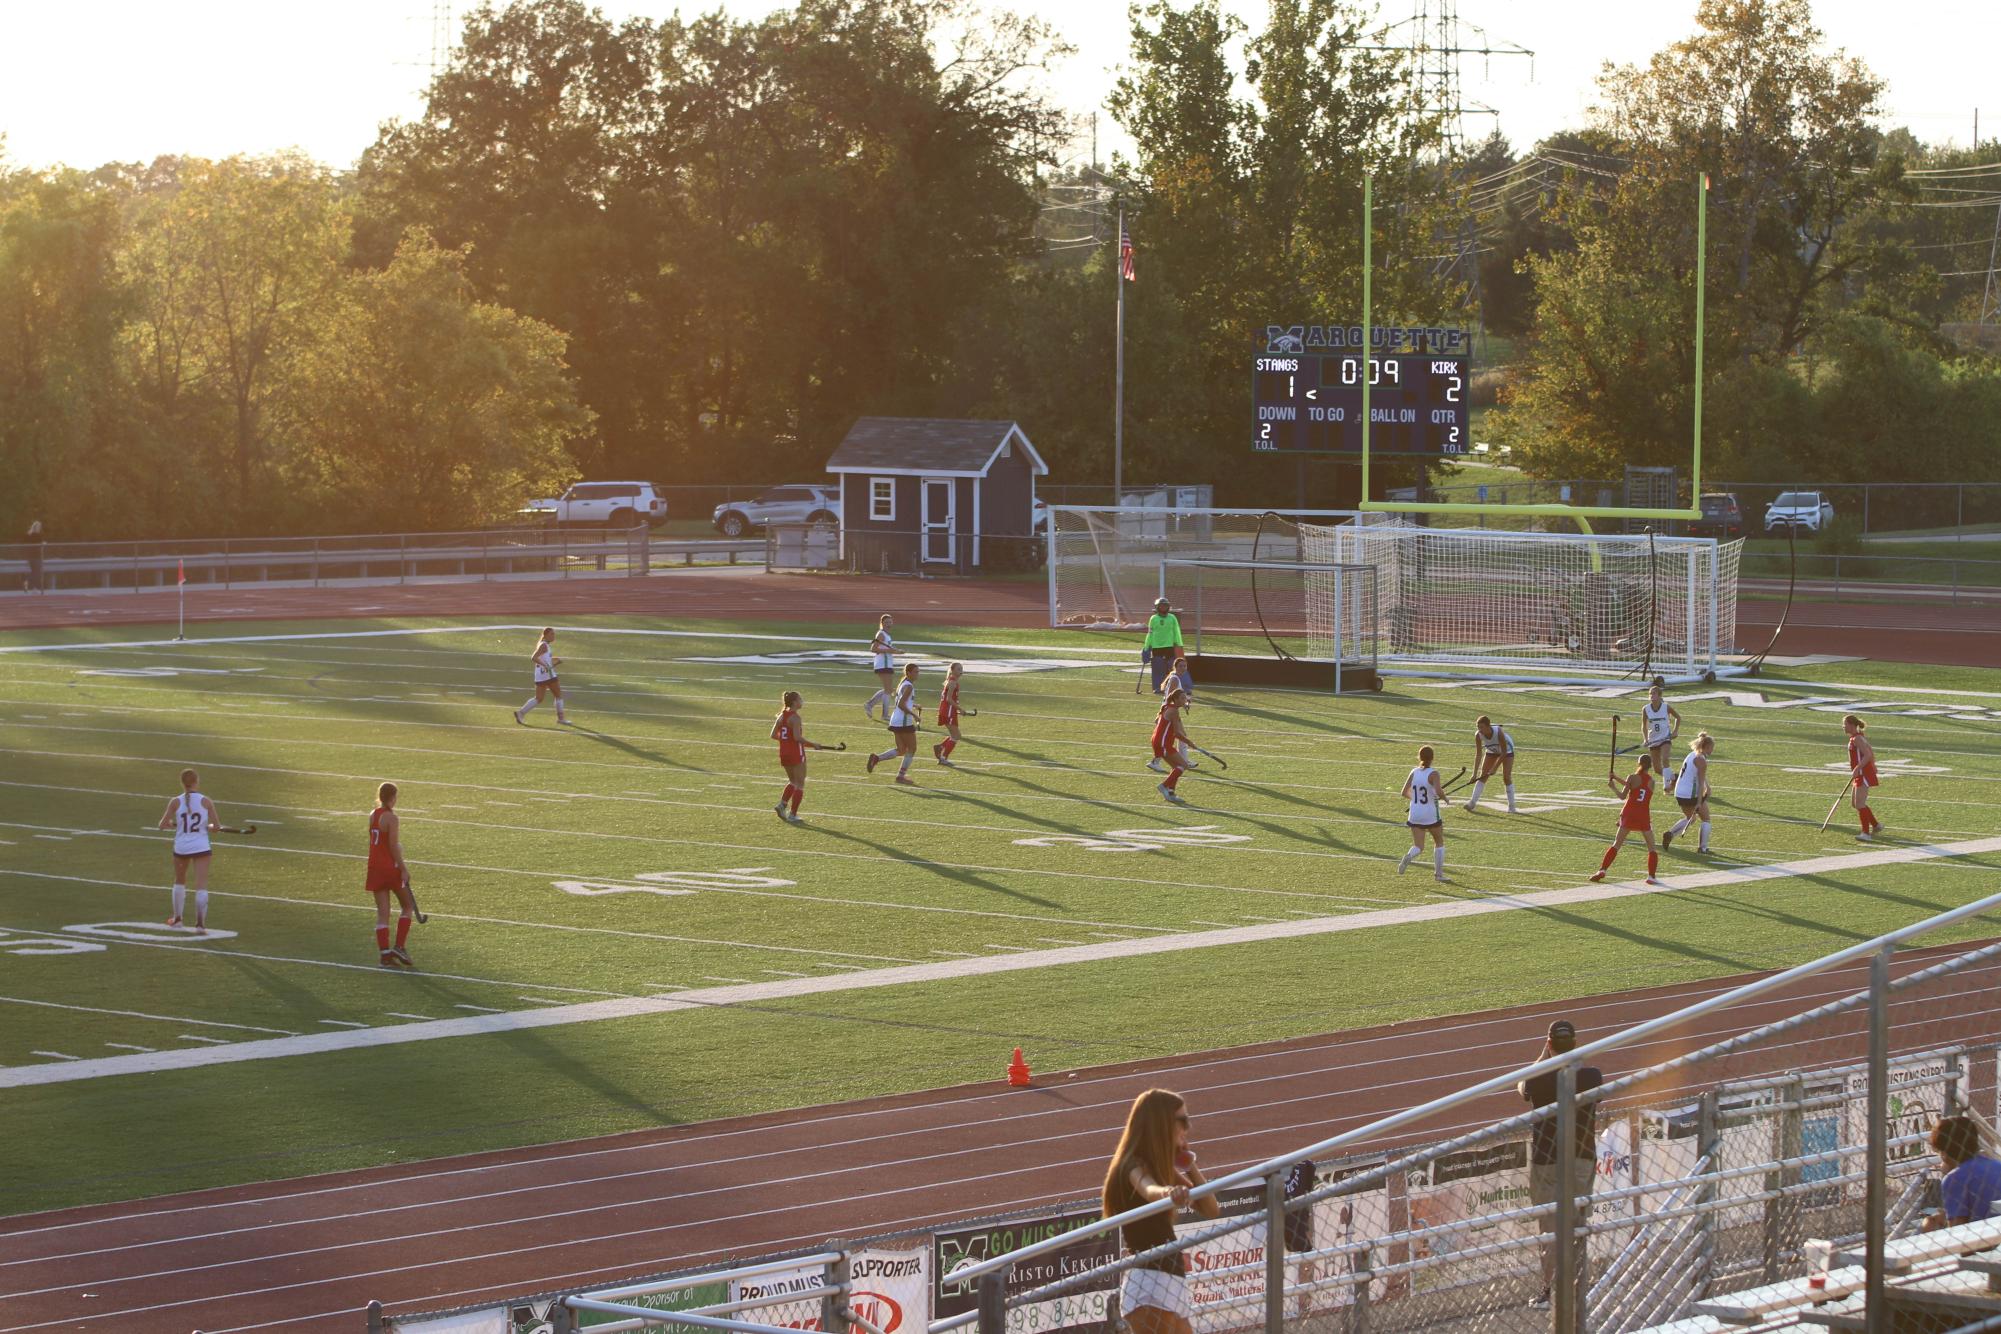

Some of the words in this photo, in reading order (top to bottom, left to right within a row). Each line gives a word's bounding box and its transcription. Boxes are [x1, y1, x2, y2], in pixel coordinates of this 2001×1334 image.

[1266, 325, 1461, 354] MARQUETTE
[1256, 358, 1299, 371] STANGS
[1431, 361, 1458, 374] KIRK
[1289, 376, 1294, 398] 1
[1446, 376, 1461, 402] 2
[1258, 406, 1297, 421] DOWN
[1308, 407, 1324, 421] TO
[1327, 408, 1345, 422] GO
[1370, 408, 1398, 422] BALL
[1400, 409, 1416, 423] ON
[1431, 409, 1456, 424] QTR
[1260, 423, 1271, 439] 2
[1449, 426, 1459, 442] 2
[1254, 440, 1279, 451] T.O.L.
[1412, 784, 1429, 805] 13
[1636, 788, 1647, 802] 3
[179, 811, 202, 834] 12
[991, 1231, 1015, 1256] GO
[851, 1256, 922, 1280] SUPPORTER
[1194, 1247, 1266, 1272] SUPERIOR
[1009, 1264, 1054, 1284] RISTO
[1060, 1254, 1116, 1276] KEKICH
[642, 1290, 679, 1309] Sponsor
